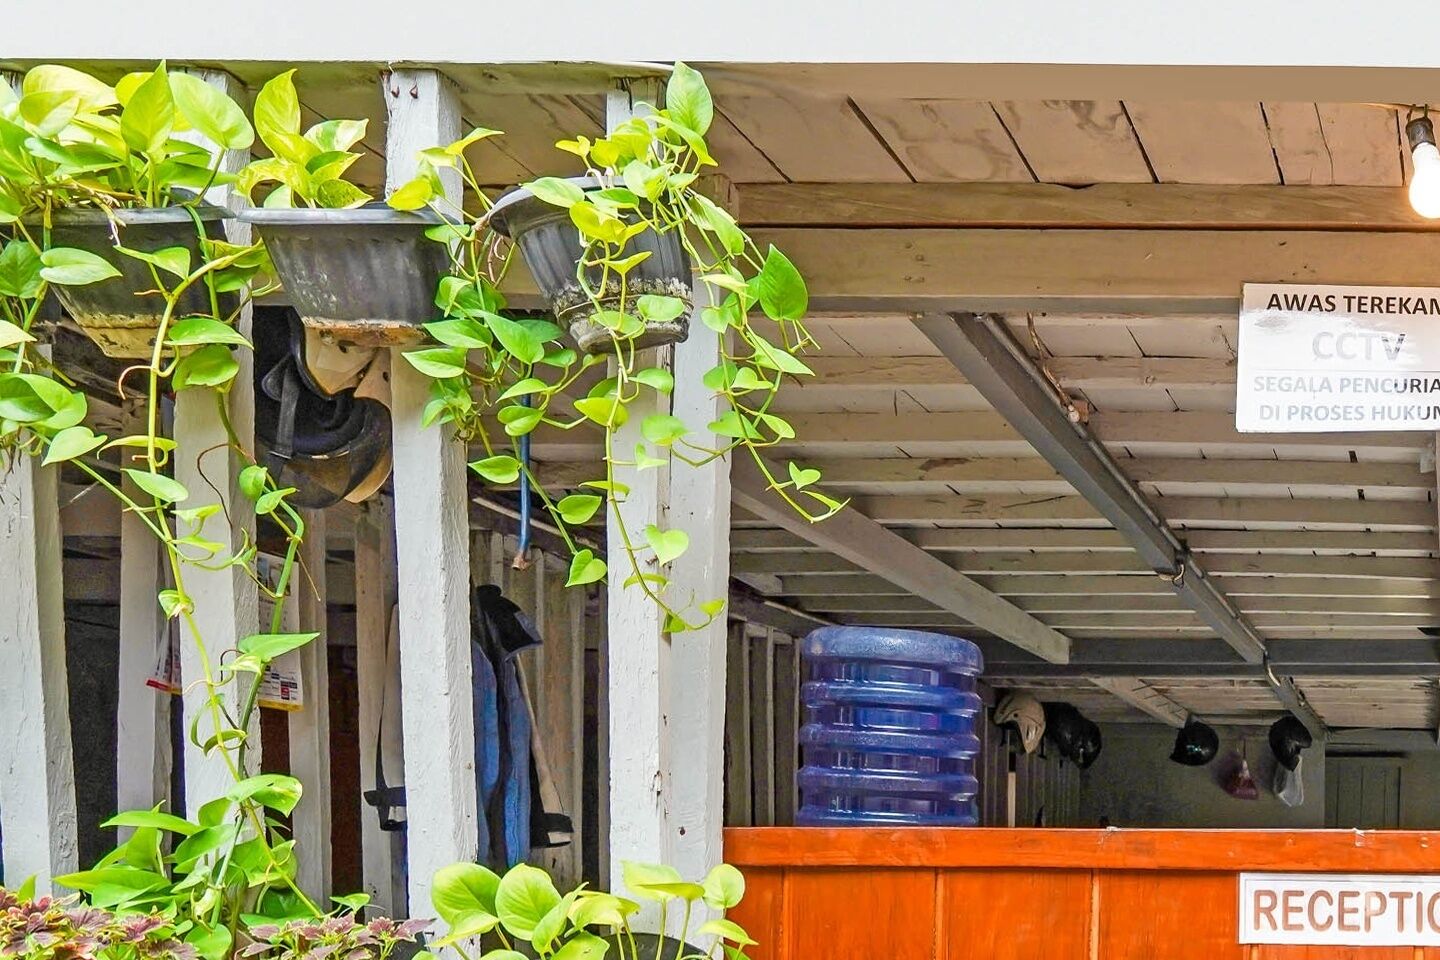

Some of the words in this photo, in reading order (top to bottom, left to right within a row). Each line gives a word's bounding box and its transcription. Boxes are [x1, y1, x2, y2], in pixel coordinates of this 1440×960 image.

[1266, 293, 1336, 313] AWAS
[1312, 330, 1406, 361] CCTV
[1254, 375, 1332, 393] SEGALA
[1260, 405, 1280, 421] DI
[1287, 404, 1364, 421] PROSES
